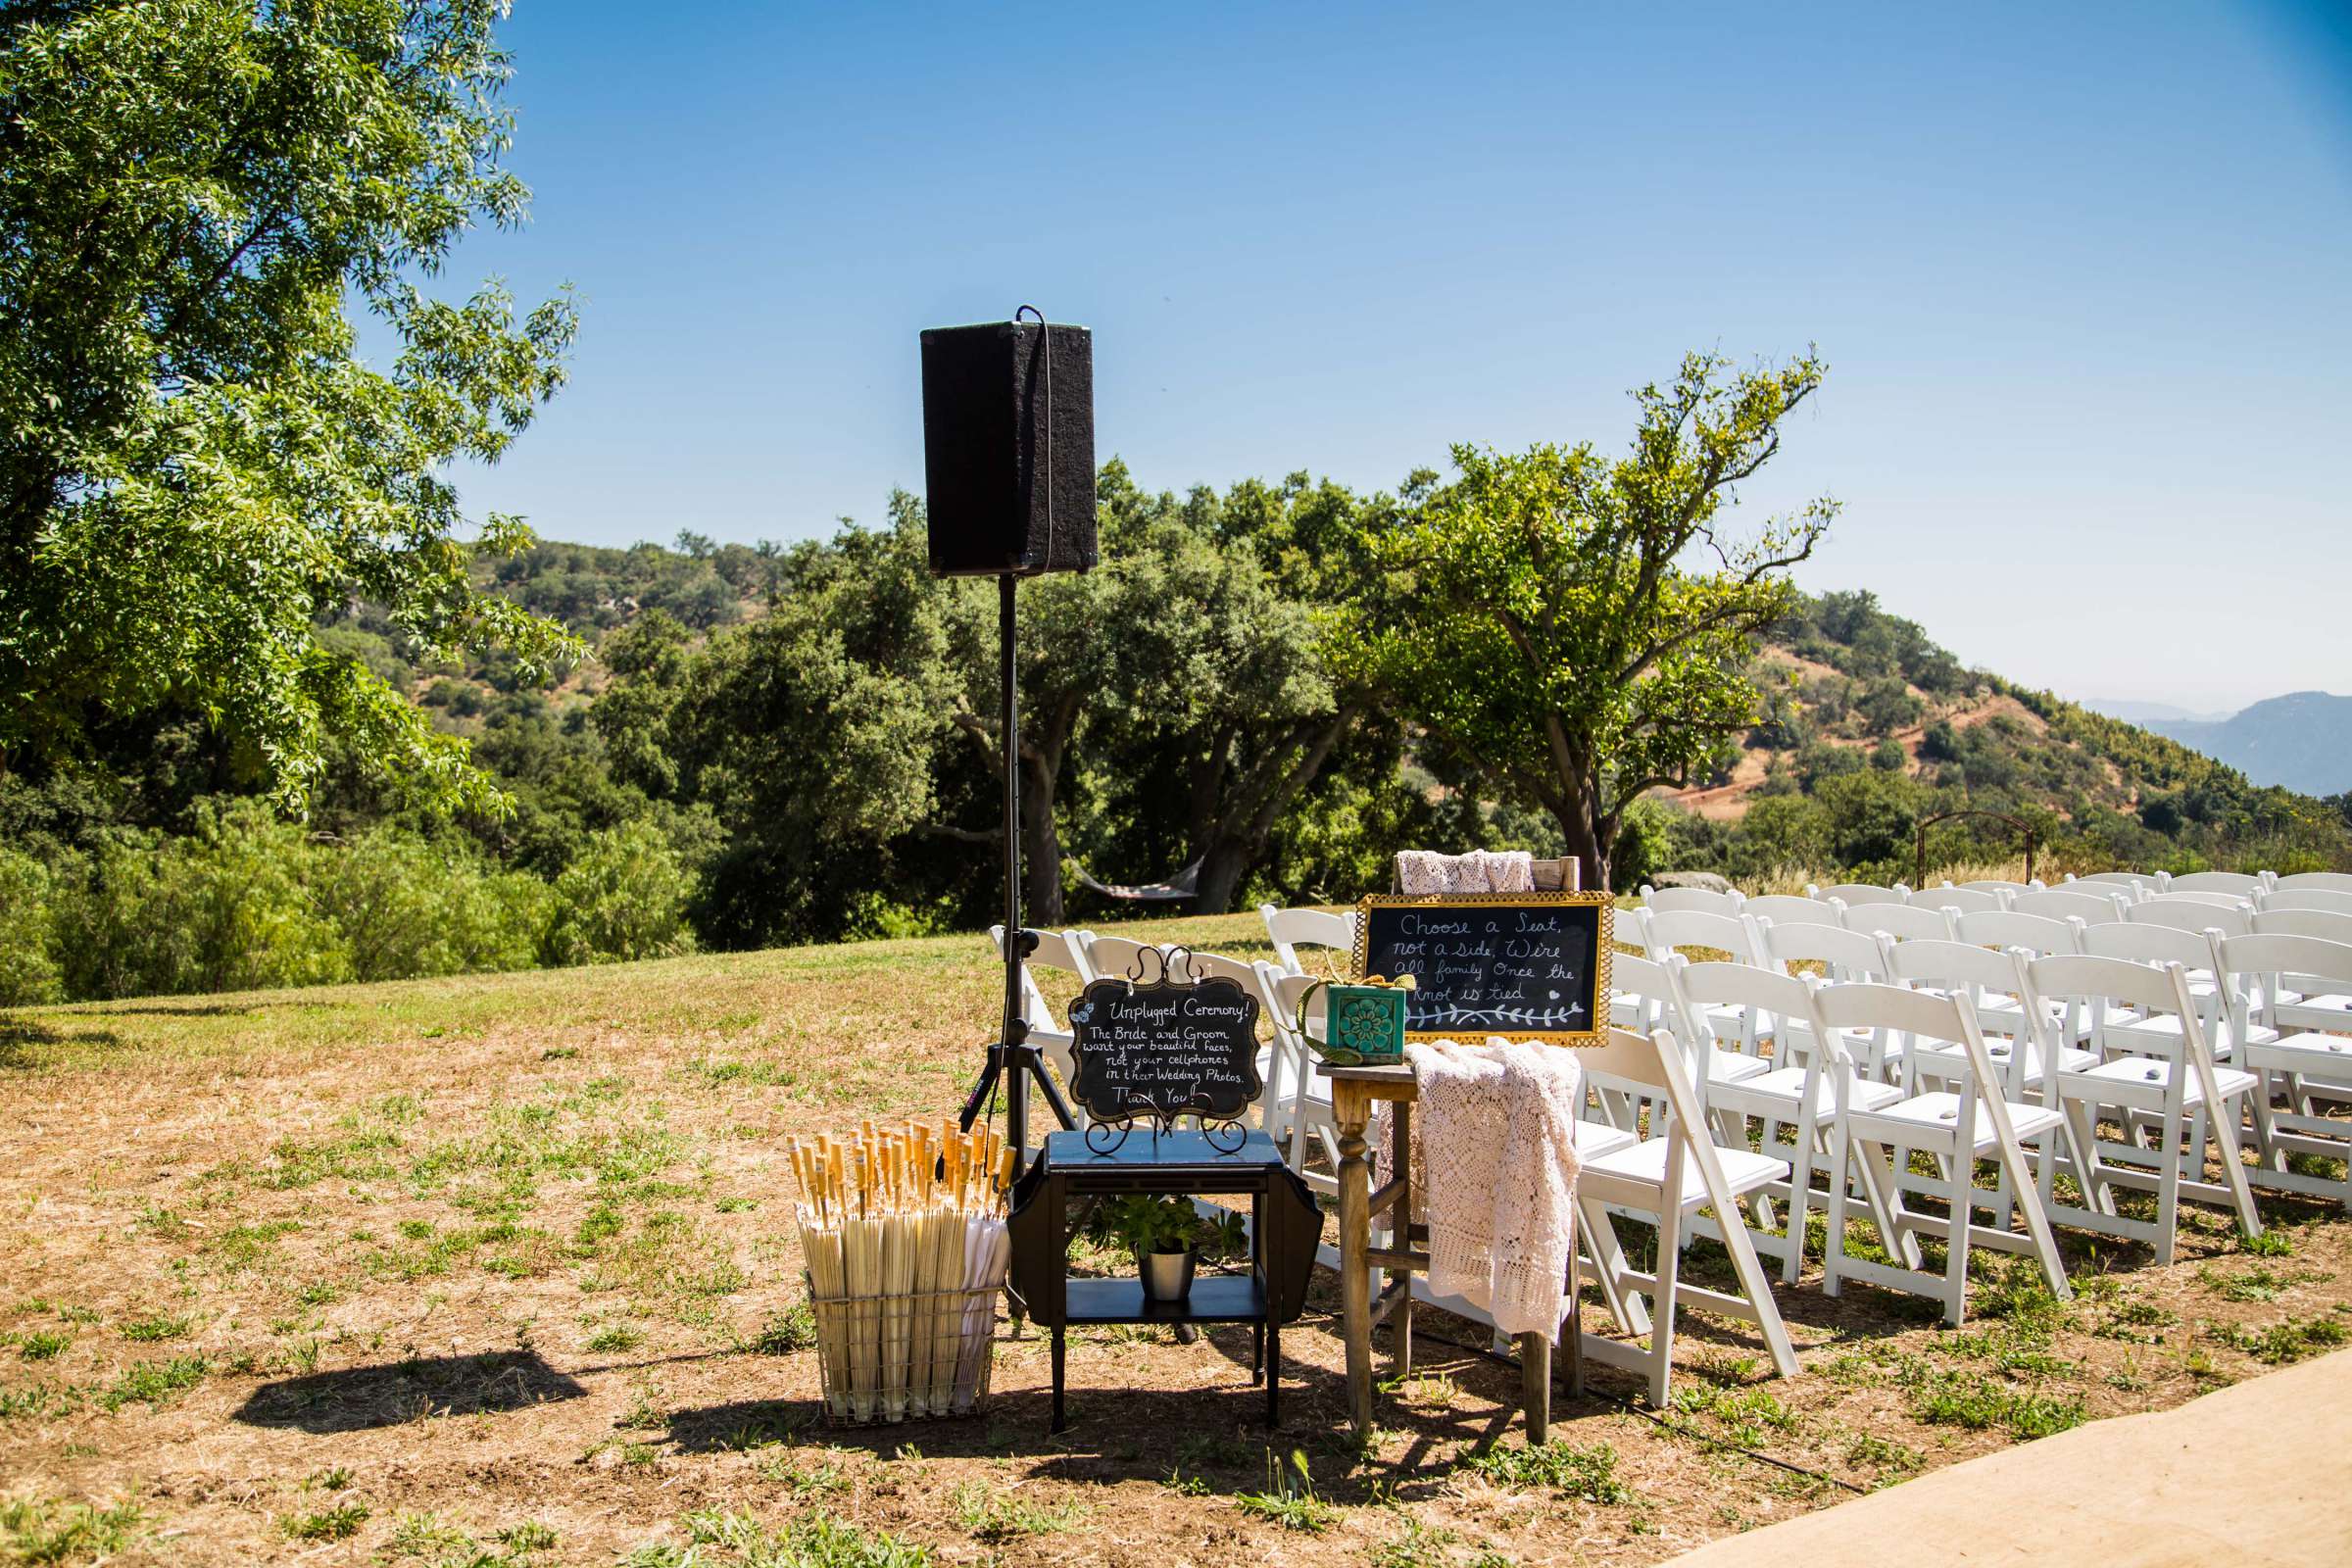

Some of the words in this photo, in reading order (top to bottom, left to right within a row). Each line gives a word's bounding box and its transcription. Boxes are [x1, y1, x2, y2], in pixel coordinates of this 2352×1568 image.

[1400, 914, 1471, 934] Choose
[1486, 921, 1499, 933] a
[1394, 940, 1427, 956] not
[1435, 945, 1447, 956] a
[1436, 959, 1483, 983] family
[1545, 963, 1575, 979] the
[1459, 984, 1482, 1001] is
[1487, 982, 1525, 1001] tied
[1109, 1001, 1178, 1026] Unplugged
[1184, 998, 1250, 1023] Ceremony!
[1090, 1026, 1110, 1040] The
[1114, 1026, 1148, 1040] Bride
[1156, 1027, 1180, 1040] and
[1184, 1026, 1230, 1041] Groom
[1083, 1042, 1114, 1052] want
[1119, 1043, 1145, 1054] your
[1105, 1055, 1128, 1066] not
[1134, 1057, 1162, 1070] your
[1168, 1054, 1229, 1066] cellphones
[1105, 1068, 1119, 1079] in
[1124, 1068, 1154, 1080] their
[1156, 1068, 1200, 1084] Wedding
